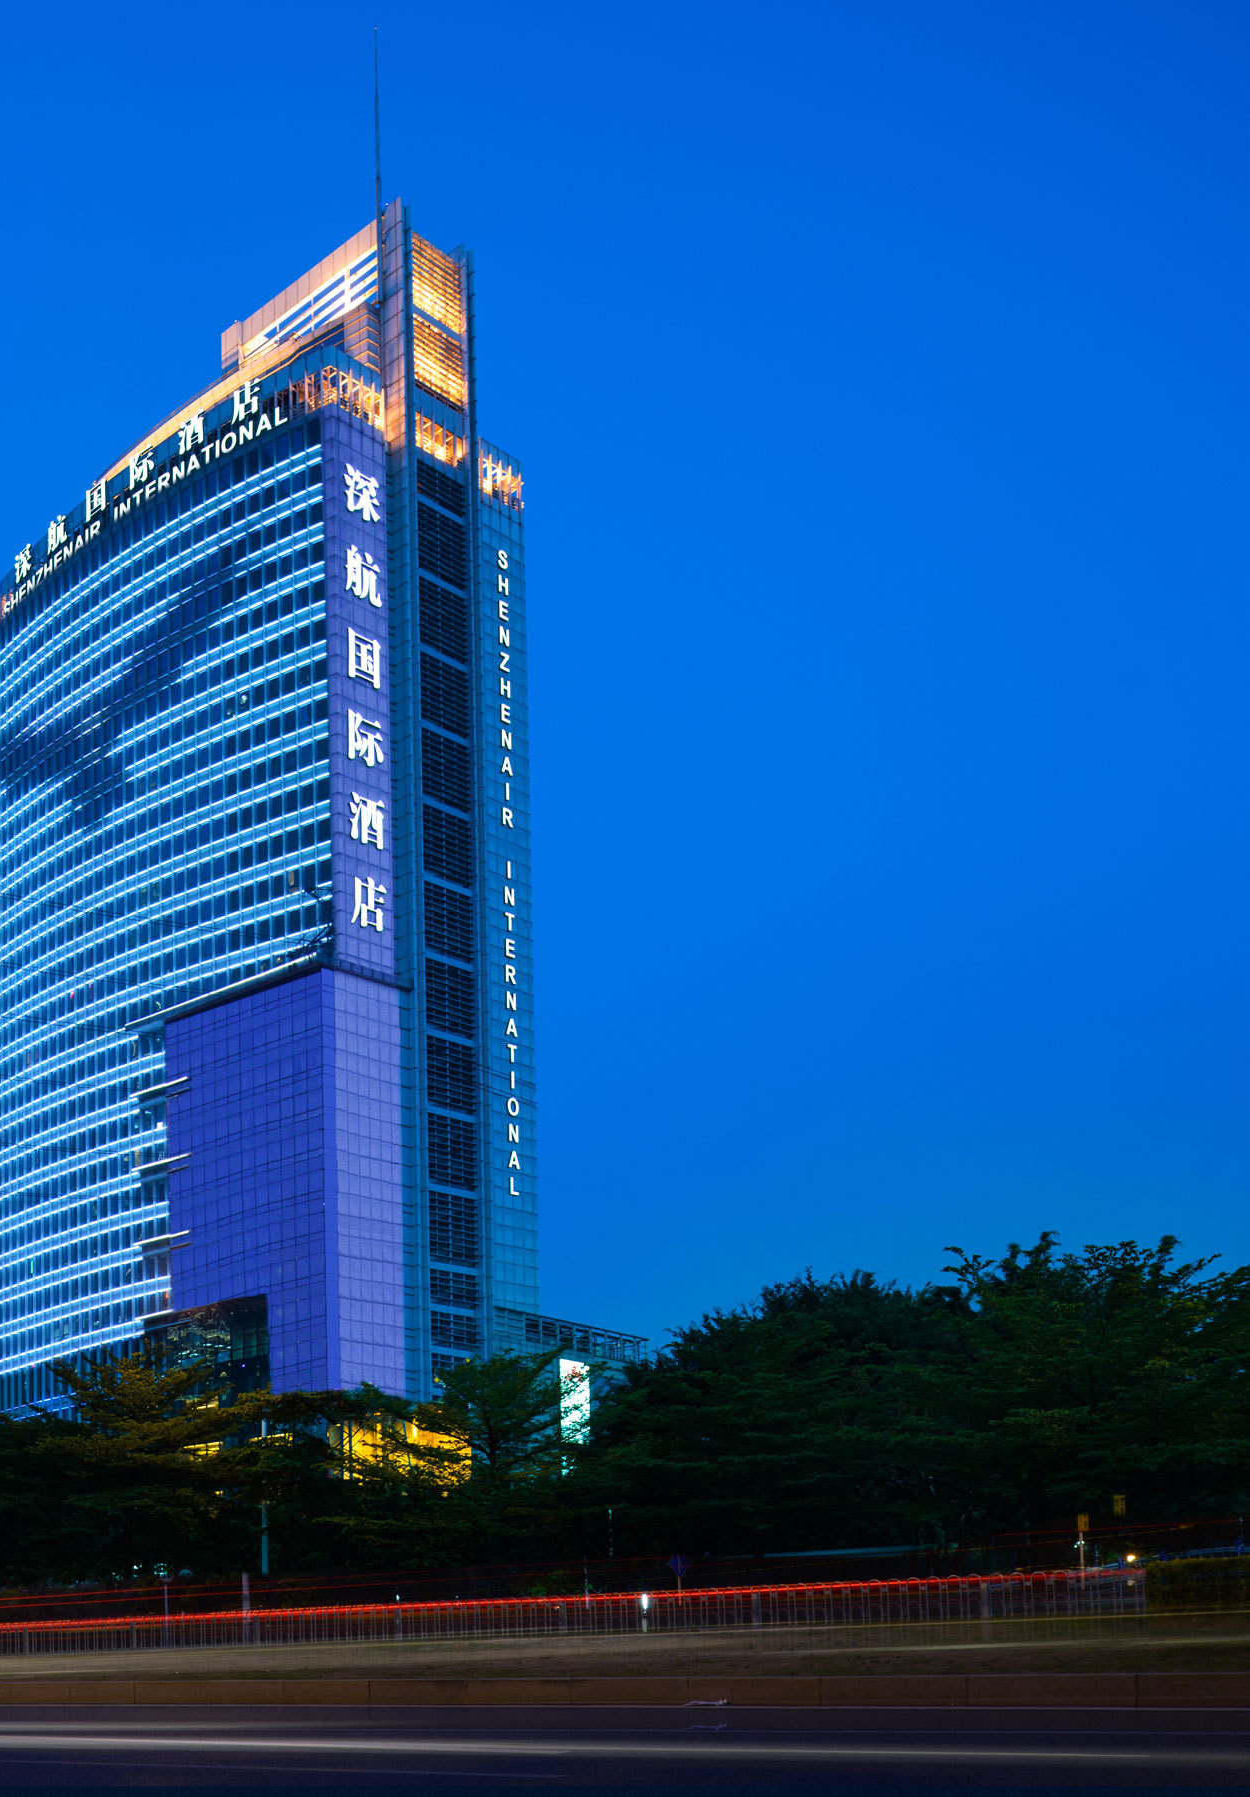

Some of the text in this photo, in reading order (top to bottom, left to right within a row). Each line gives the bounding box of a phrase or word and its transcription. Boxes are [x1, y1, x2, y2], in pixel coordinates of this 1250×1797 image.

[3, 406, 288, 614] SHENZHENAIR INTERNATIONAL
[14, 379, 261, 584] 深航国际酒店
[343, 463, 388, 932] 深航国际酒店
[497, 549, 522, 1197] SHENZHENAIR INTERNATIONAL
